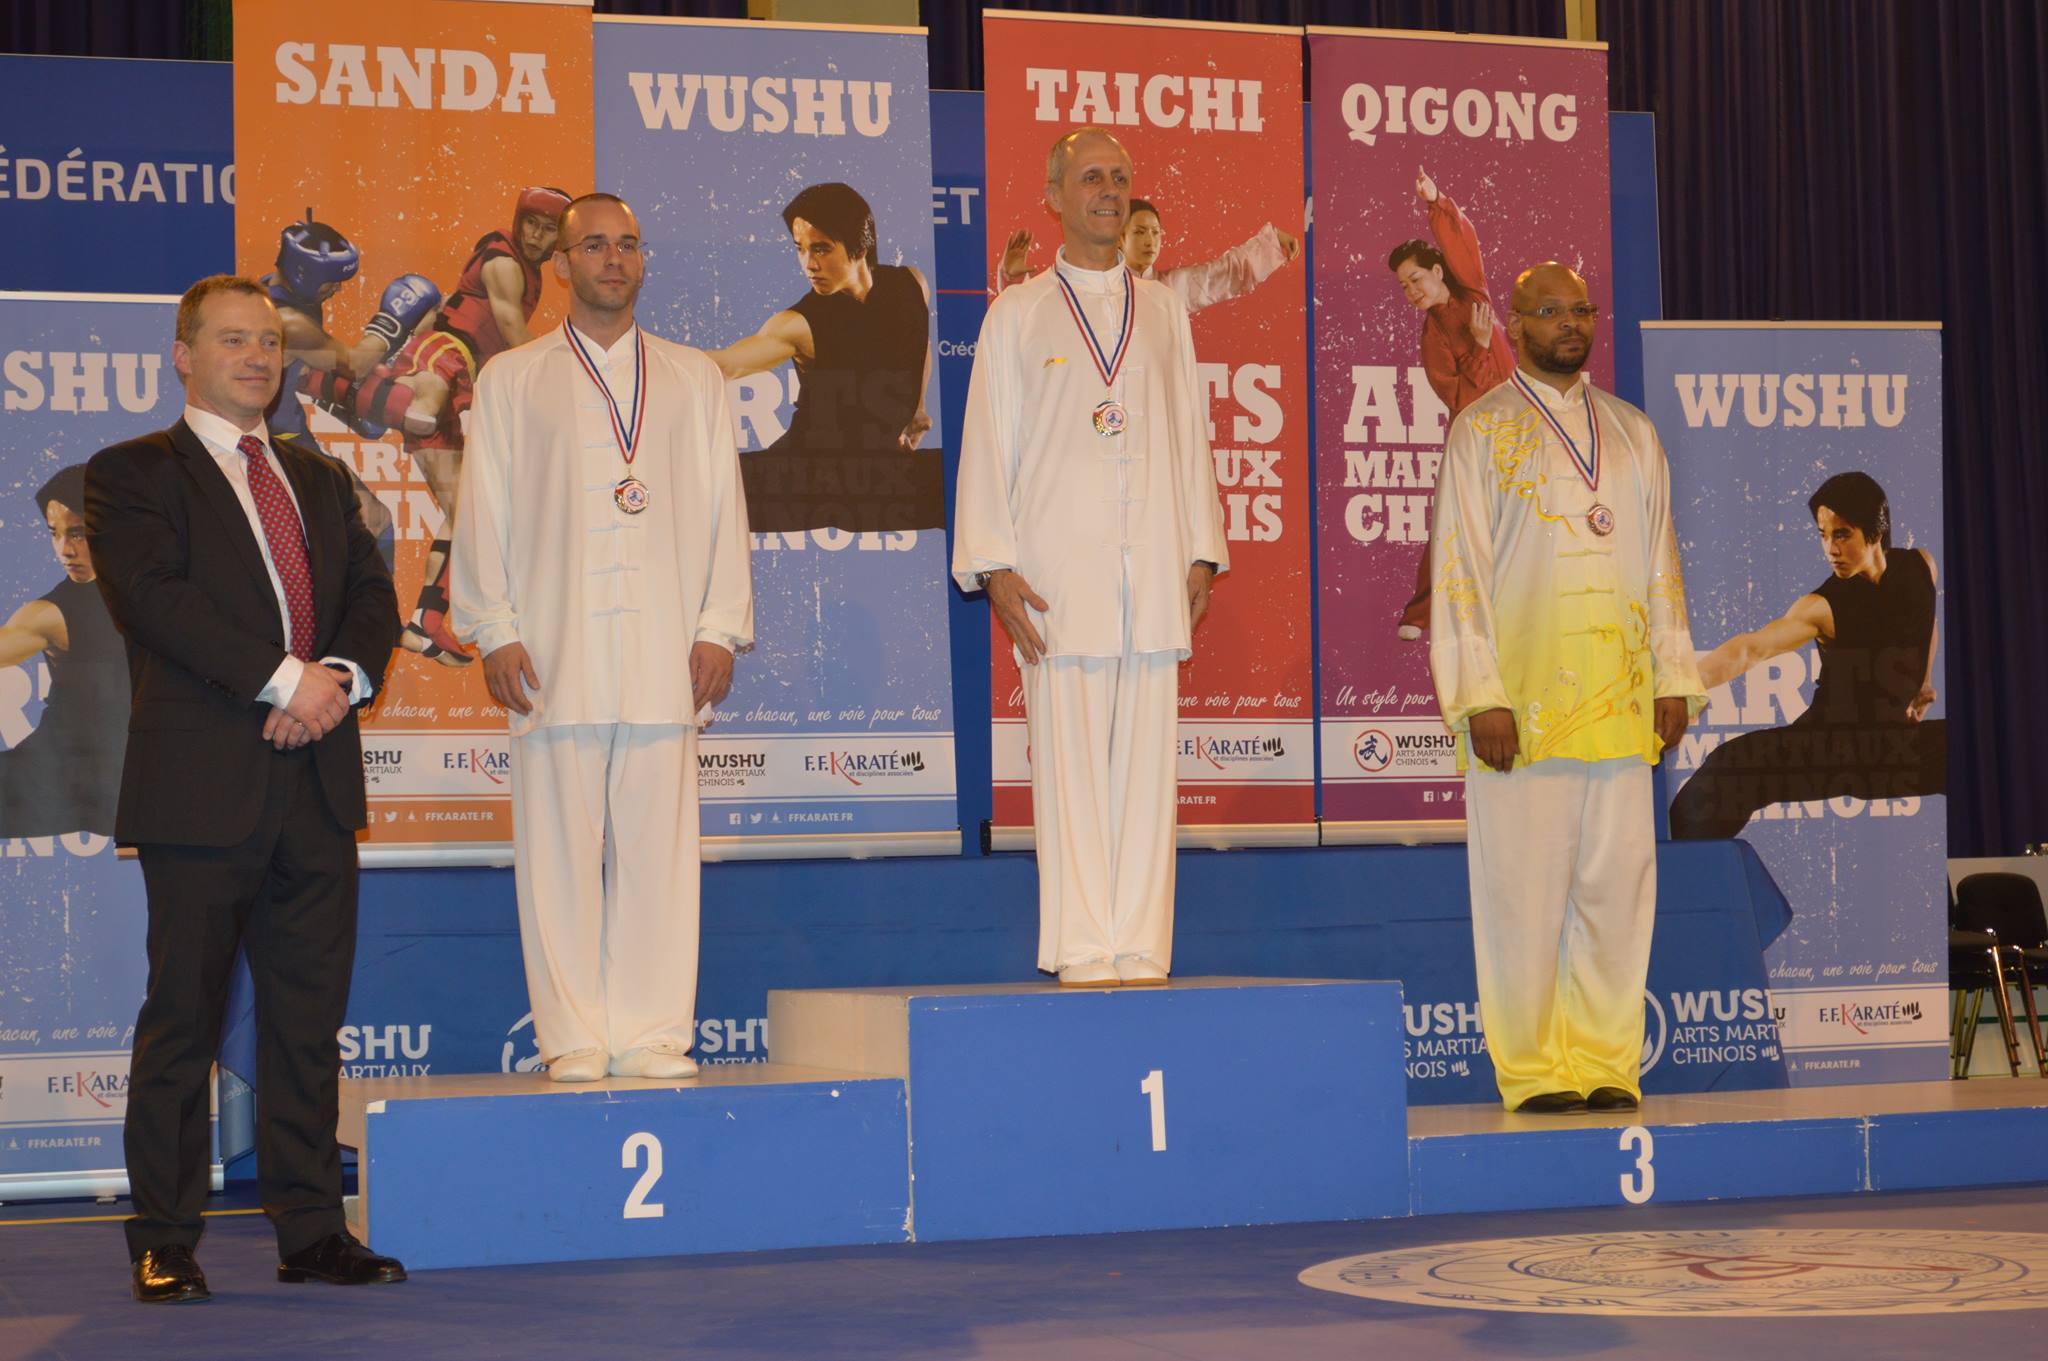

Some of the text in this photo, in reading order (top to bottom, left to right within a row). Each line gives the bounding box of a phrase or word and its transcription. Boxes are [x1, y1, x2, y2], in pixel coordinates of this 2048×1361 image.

[275, 41, 556, 114] SANDA
[628, 71, 893, 137] WUSHU
[1026, 67, 1264, 133] TAICHI
[1341, 82, 1580, 147] QIGONG
[4, 350, 161, 413] SHU
[1675, 373, 1908, 428] WUSHU
[1204, 691, 1231, 707] voie
[1232, 695, 1267, 716] pour
[1273, 692, 1302, 707] tous
[1335, 685, 1435, 714] Un style pour
[745, 702, 798, 727] chacun,
[807, 710, 832, 723] une
[838, 705, 865, 721] voie
[868, 709, 905, 730] pour
[911, 704, 942, 721] tous
[1395, 735, 1456, 749] WUSHU
[697, 754, 765, 768] WUSHU
[1395, 758, 1429, 766] CHINOIS
[697, 778, 735, 787] CHINOIS
[425, 811, 494, 821] FFKARATE.FR
[788, 812, 854, 822] FFKARATE.FR
[1769, 960, 1815, 982] chacun,
[1874, 964, 1906, 982] pour
[1912, 958, 1938, 975] tous
[1672, 1026, 1720, 1044] ARTS
[1673, 1045, 1757, 1065] CHINOIS
[1141, 1070, 1166, 1151] 1
[622, 1132, 664, 1219] 2
[1620, 1126, 1655, 1205] 3
